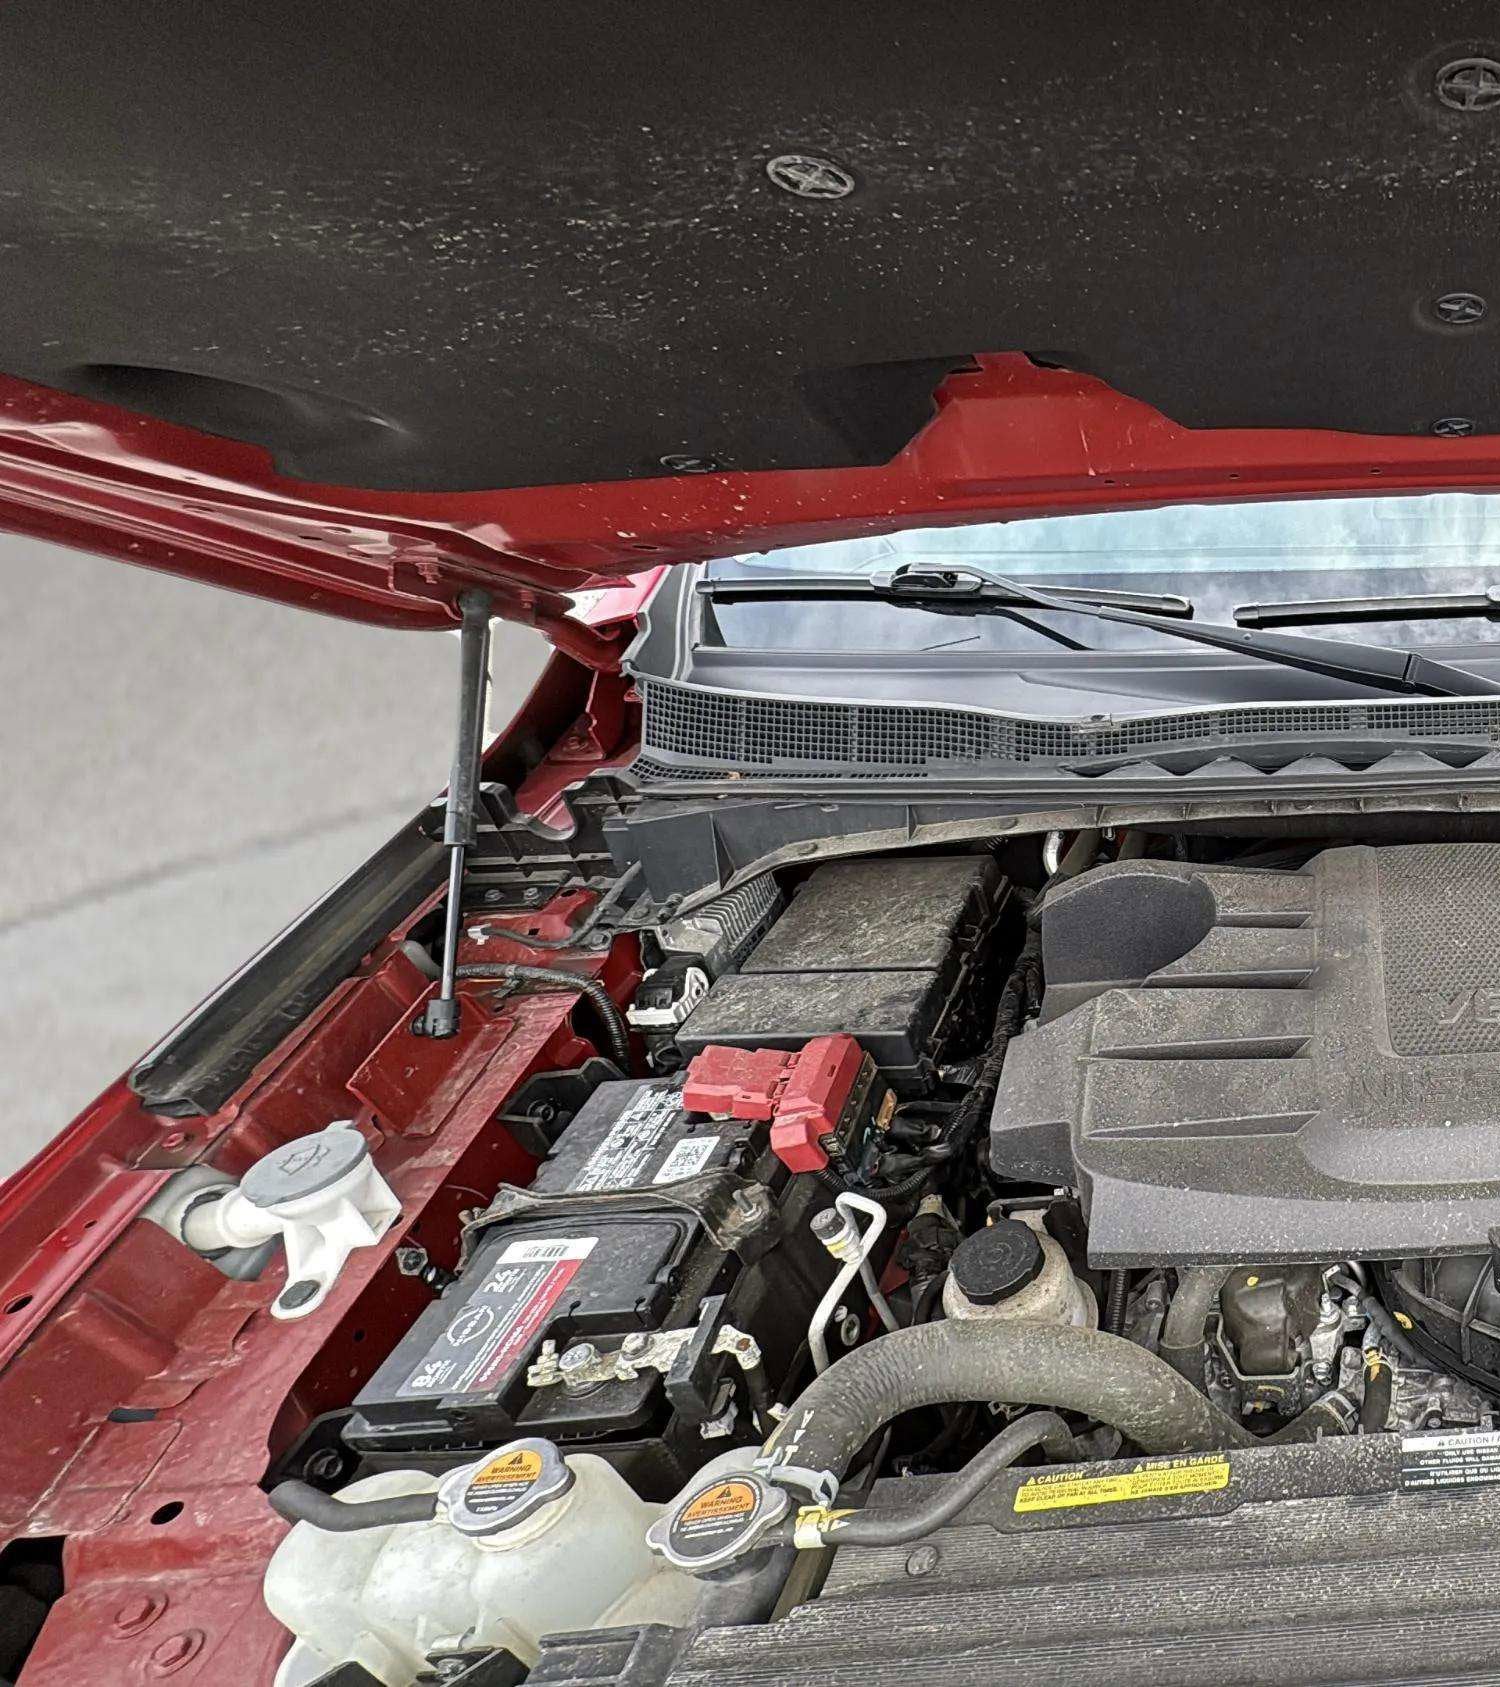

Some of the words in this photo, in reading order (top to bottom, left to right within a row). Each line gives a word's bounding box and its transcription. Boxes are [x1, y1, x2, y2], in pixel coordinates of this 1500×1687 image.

[484, 1270, 511, 1292] 24
[1448, 1436, 1489, 1447] CAUTION
[491, 1464, 532, 1473] WARNING
[1145, 1461, 1171, 1471] MISE
[1173, 1459, 1187, 1468] EN
[1189, 1455, 1225, 1466] GARDE
[1037, 1471, 1084, 1485] CAUTION
[700, 1496, 743, 1509] WARNING
